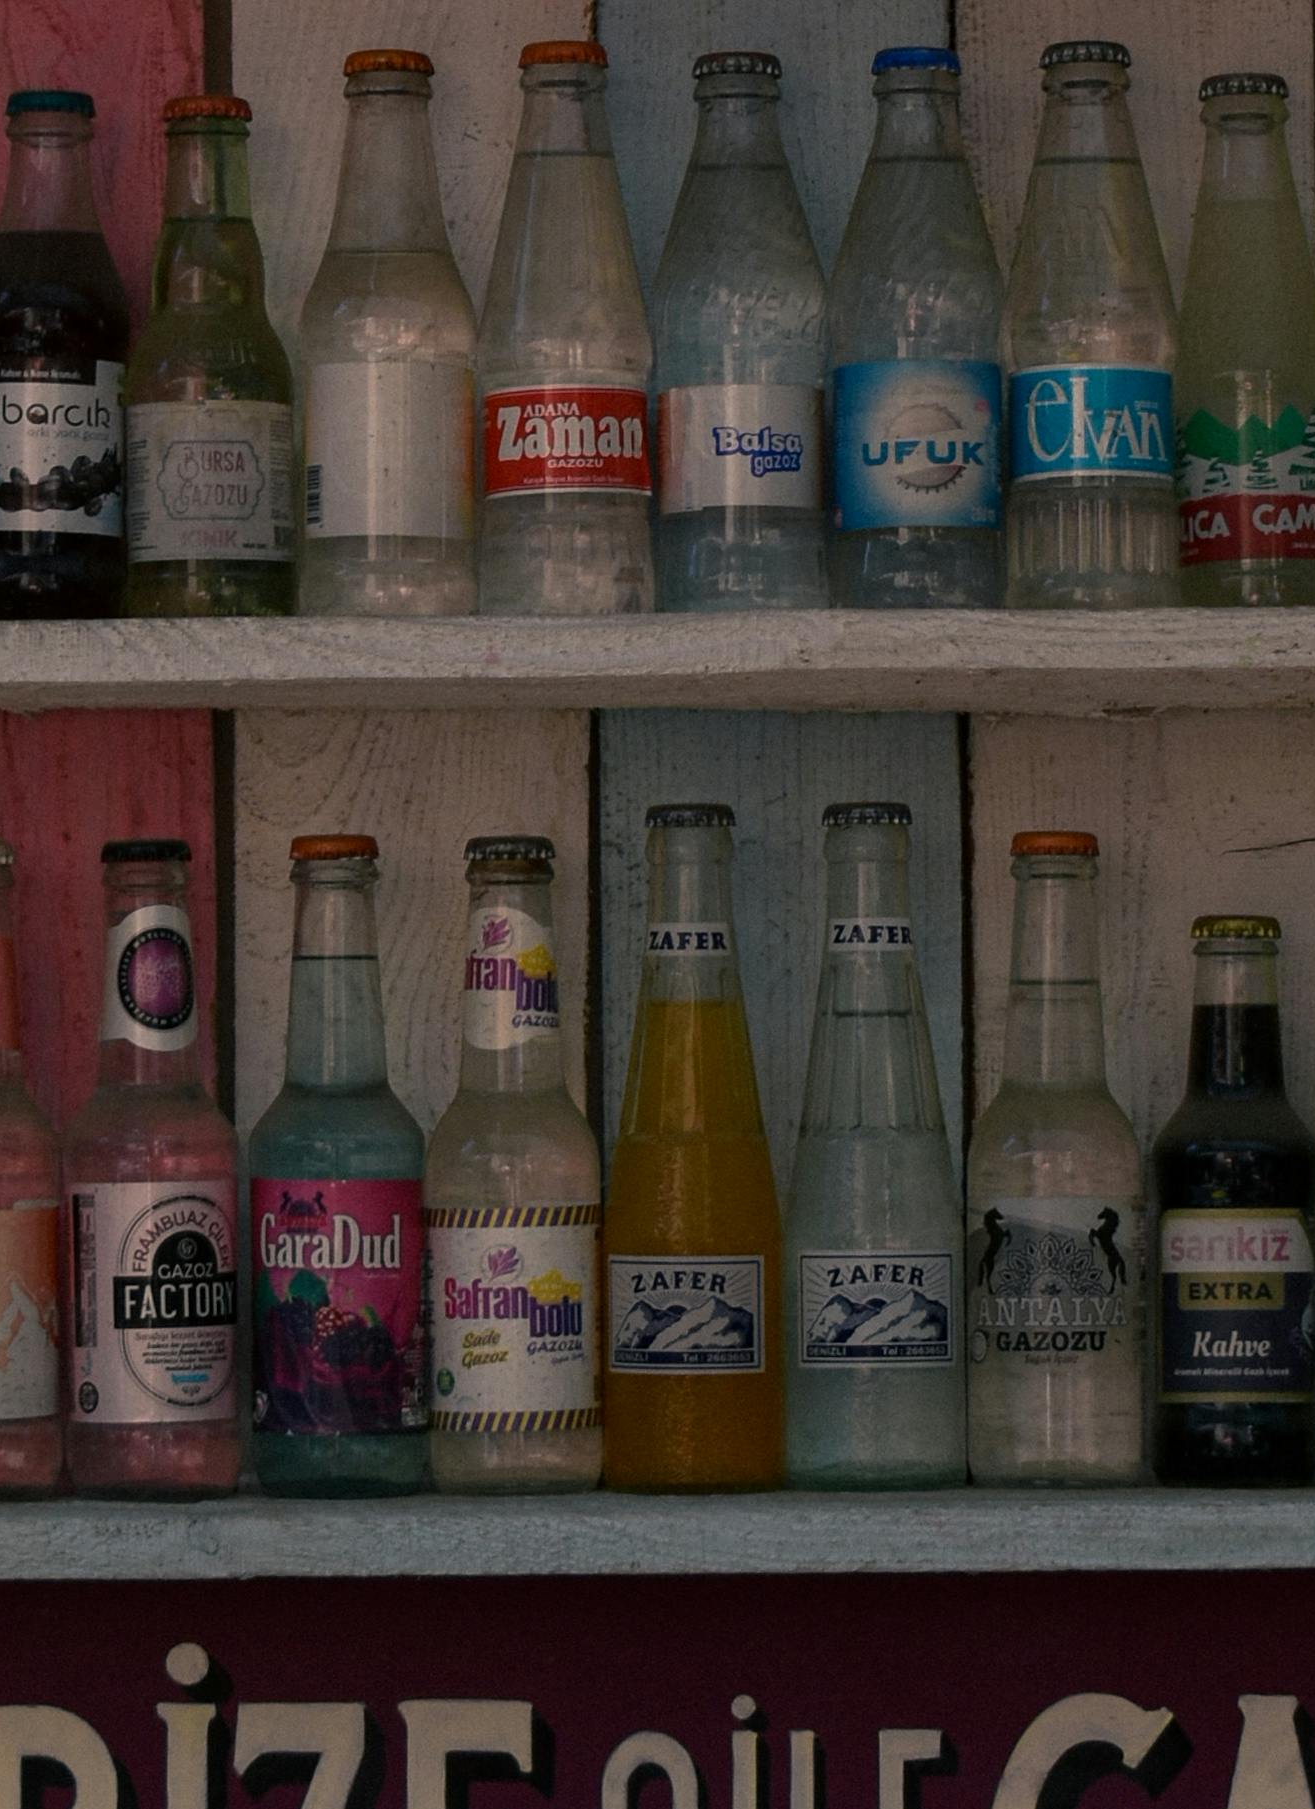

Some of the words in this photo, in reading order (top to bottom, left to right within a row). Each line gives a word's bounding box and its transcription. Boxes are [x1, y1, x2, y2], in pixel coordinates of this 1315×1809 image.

[523, 402, 581, 417] ADANA
[496, 406, 644, 461] Zaman
[713, 426, 804, 456] Balsa
[177, 447, 247, 480] BURSA
[547, 458, 605, 469] GAZOZU
[750, 452, 802, 477] gazoz
[862, 439, 984, 466] UFUK
[173, 481, 248, 513] GAZOZU
[649, 931, 727, 950] ZAFER
[833, 924, 913, 944] ZAFER
[133, 1210, 207, 1273] FRAMBUAZ
[260, 1213, 401, 1269] GaraDud
[157, 1263, 214, 1280] GAZOZ
[631, 1271, 727, 1293] ZAFER
[827, 1264, 925, 1287] ZAFER
[124, 1281, 235, 1321] FACTORY
[1188, 1282, 1273, 1300] EXTRA
[977, 1297, 1128, 1327] ANTALYA
[462, 1329, 501, 1349] Sade
[996, 1331, 1107, 1352] GAZOZU
[1192, 1330, 1271, 1358] Kahve
[462, 1350, 509, 1370] Gazoz
